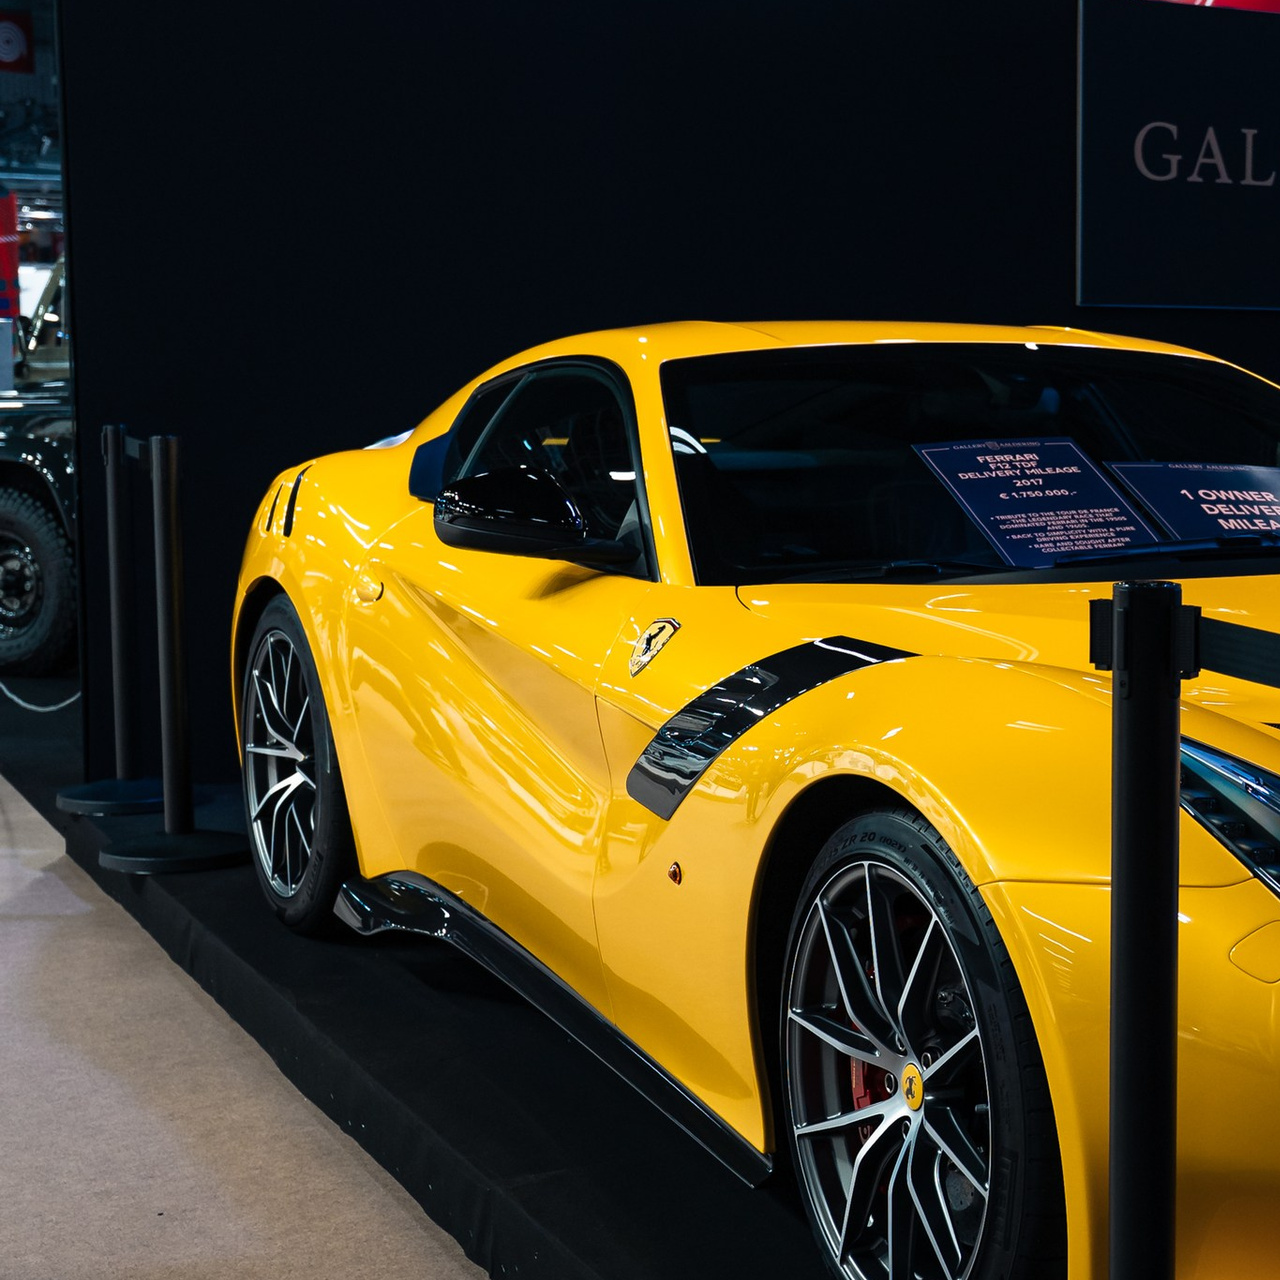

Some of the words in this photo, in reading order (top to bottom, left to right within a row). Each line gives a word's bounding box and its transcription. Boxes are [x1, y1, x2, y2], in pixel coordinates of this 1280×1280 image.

[976, 453, 1040, 463] FERRARI
[989, 462, 1012, 470] F12
[1012, 461, 1038, 469] TDF
[957, 469, 1022, 480] DELIVERY
[1025, 466, 1082, 476] MILEAGE
[1012, 478, 1044, 487] 2017
[1180, 489, 1195, 501] 1
[1197, 489, 1279, 502] OWNER
[994, 513, 1027, 521] TRIBUTE
[1028, 514, 1072, 522] LEGENDARY
[999, 521, 1046, 530] DOMINATED
[1036, 535, 1069, 543] DRIVING
[1069, 532, 1117, 540] EXPERIENCE
[1046, 529, 1087, 537] SIMPLICITY
[1041, 545, 1094, 553] COLLECTABLE
[859, 831, 877, 843] 20
